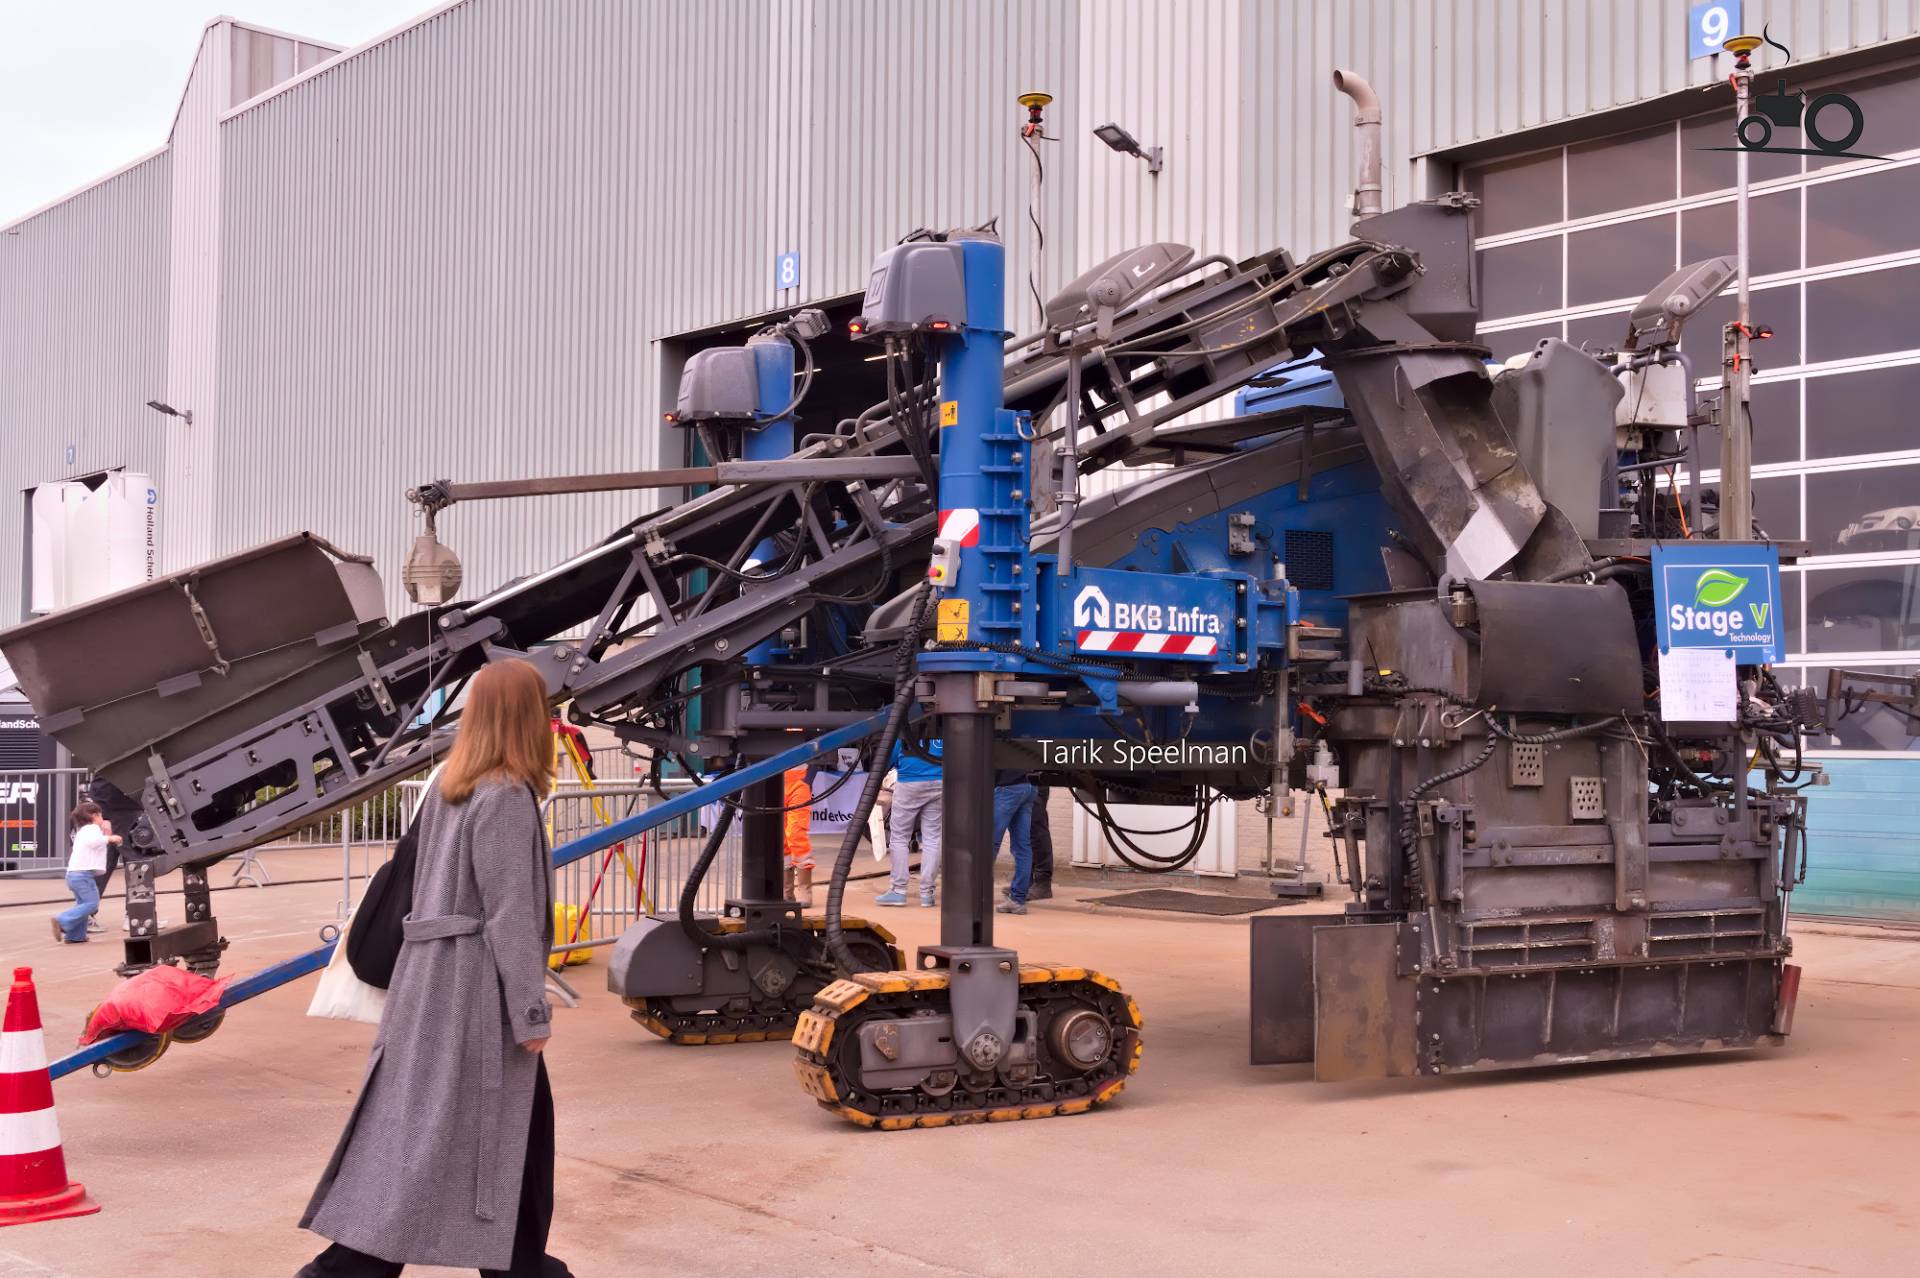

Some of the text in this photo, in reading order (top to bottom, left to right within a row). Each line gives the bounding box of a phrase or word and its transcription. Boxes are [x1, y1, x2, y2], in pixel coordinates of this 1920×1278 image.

[1702, 6, 1729, 47] 9
[783, 257, 795, 283] 8
[147, 506, 155, 547] Holland
[1114, 603, 1220, 634] BKB Infra
[1670, 602, 1769, 637] Stage V
[1729, 632, 1771, 643] Technology
